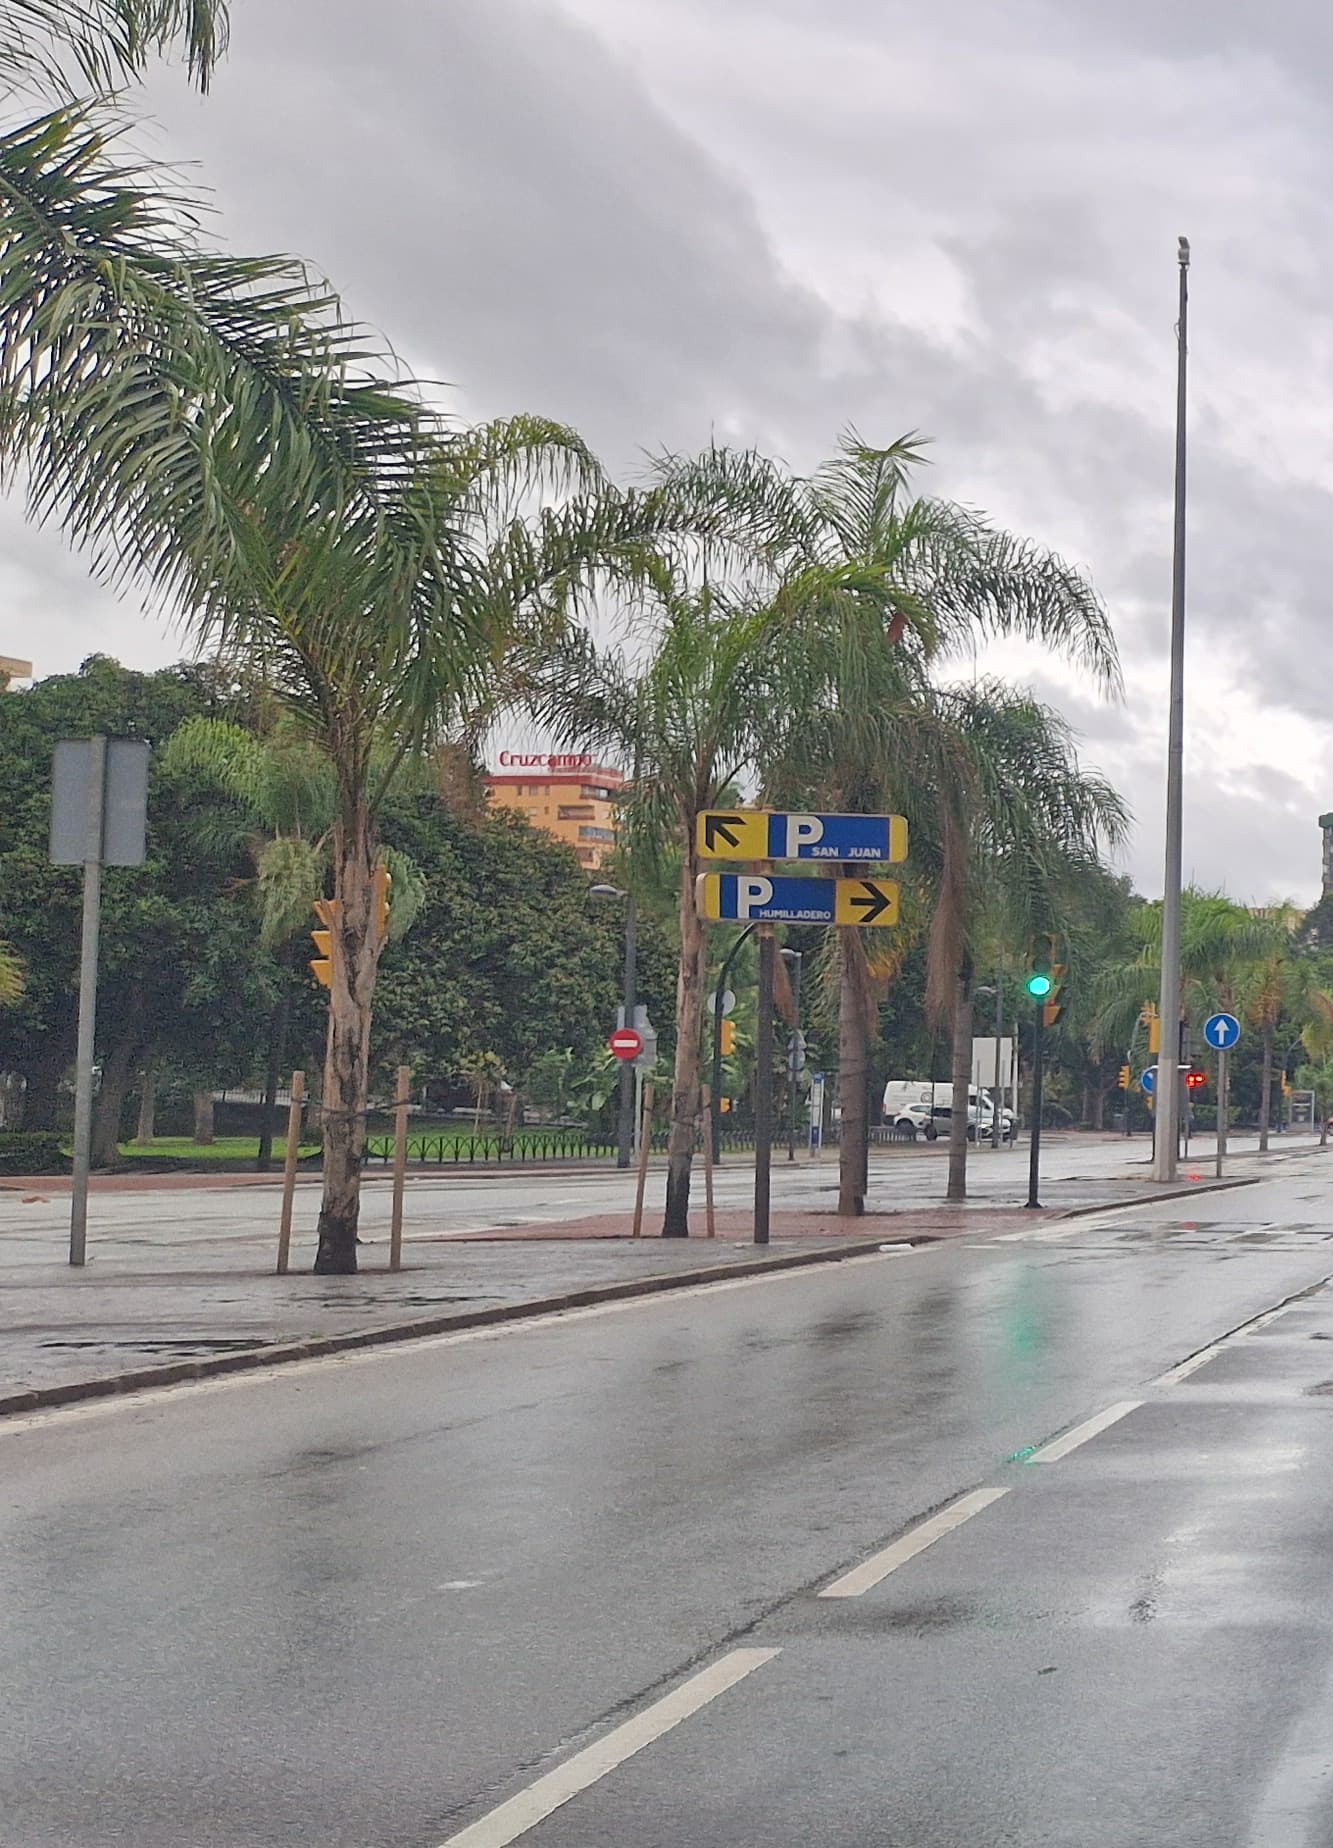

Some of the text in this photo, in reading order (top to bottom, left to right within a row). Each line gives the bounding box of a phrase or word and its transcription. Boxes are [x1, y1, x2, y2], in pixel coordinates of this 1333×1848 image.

[499, 751, 592, 767] Cruzcampo
[787, 815, 824, 858] P
[812, 847, 881, 858] SAN JUAN
[737, 876, 773, 918] P
[759, 909, 831, 920] HUMILLADERO
